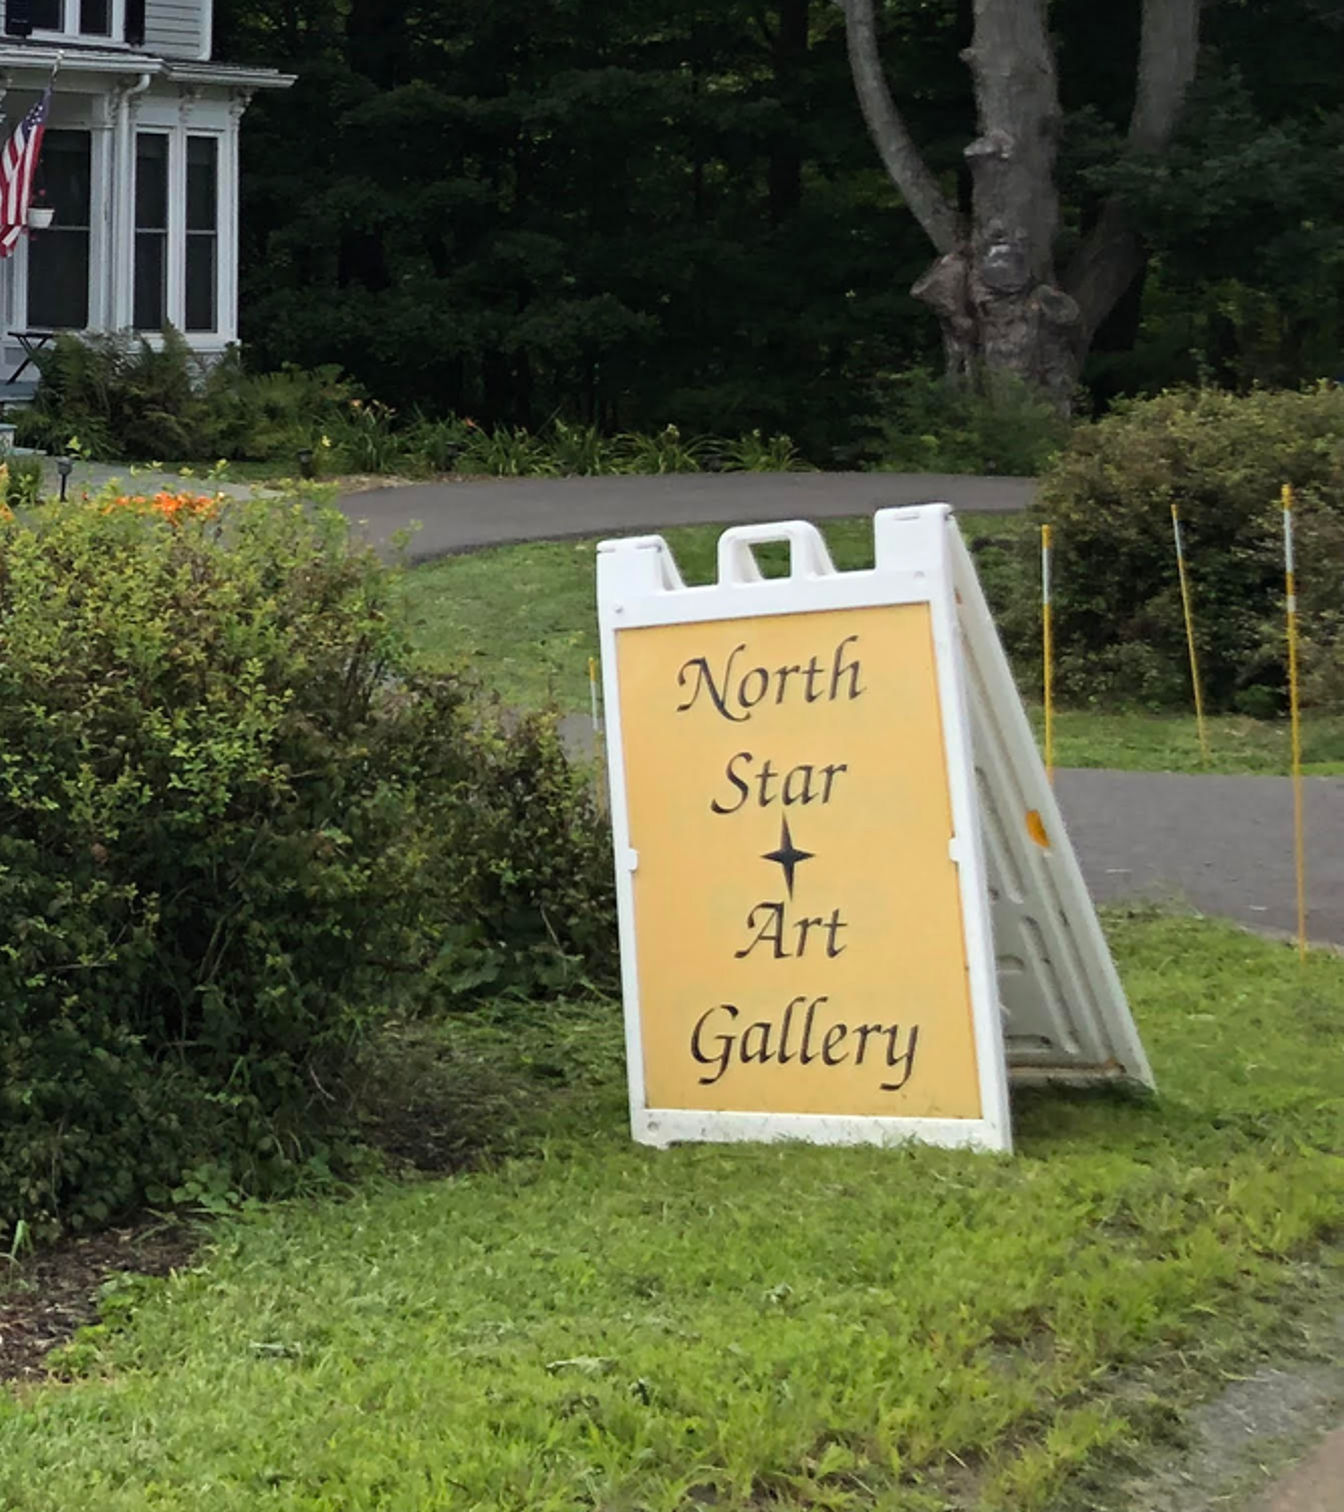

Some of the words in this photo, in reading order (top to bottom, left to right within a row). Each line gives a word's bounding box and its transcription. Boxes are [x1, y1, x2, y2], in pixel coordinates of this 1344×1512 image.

[676, 635, 867, 722] North
[711, 752, 847, 815] Star
[734, 902, 847, 960] Art
[690, 997, 919, 1091] Gallery
